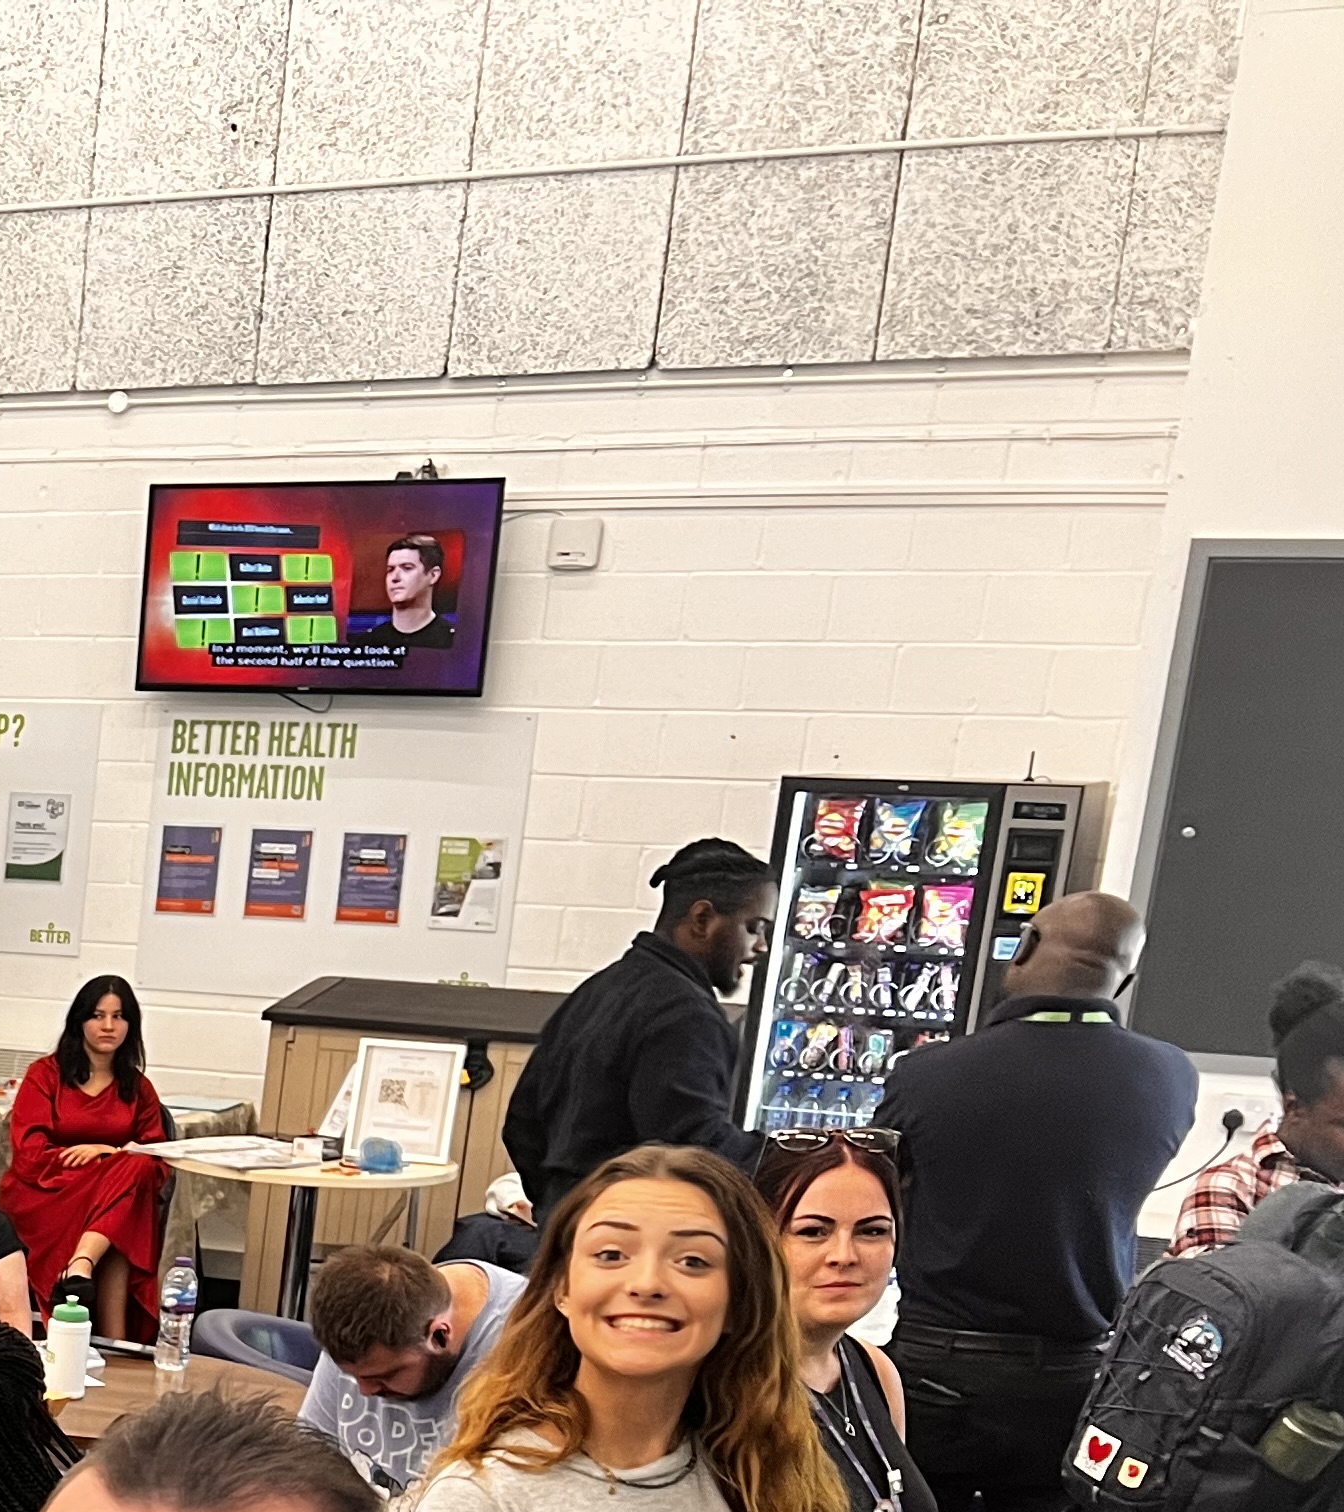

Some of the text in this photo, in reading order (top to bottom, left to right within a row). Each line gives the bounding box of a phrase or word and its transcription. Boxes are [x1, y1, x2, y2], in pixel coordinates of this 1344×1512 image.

[212, 644, 224, 654] In
[293, 645, 320, 655] we'll
[324, 645, 352, 655] have
[364, 645, 390, 655] look
[393, 647, 405, 655] at
[216, 656, 398, 669] the second half of the question.
[171, 719, 359, 759] BETTER HEALTH
[167, 761, 325, 801] INFORMATION
[29, 925, 71, 945] BETTER
